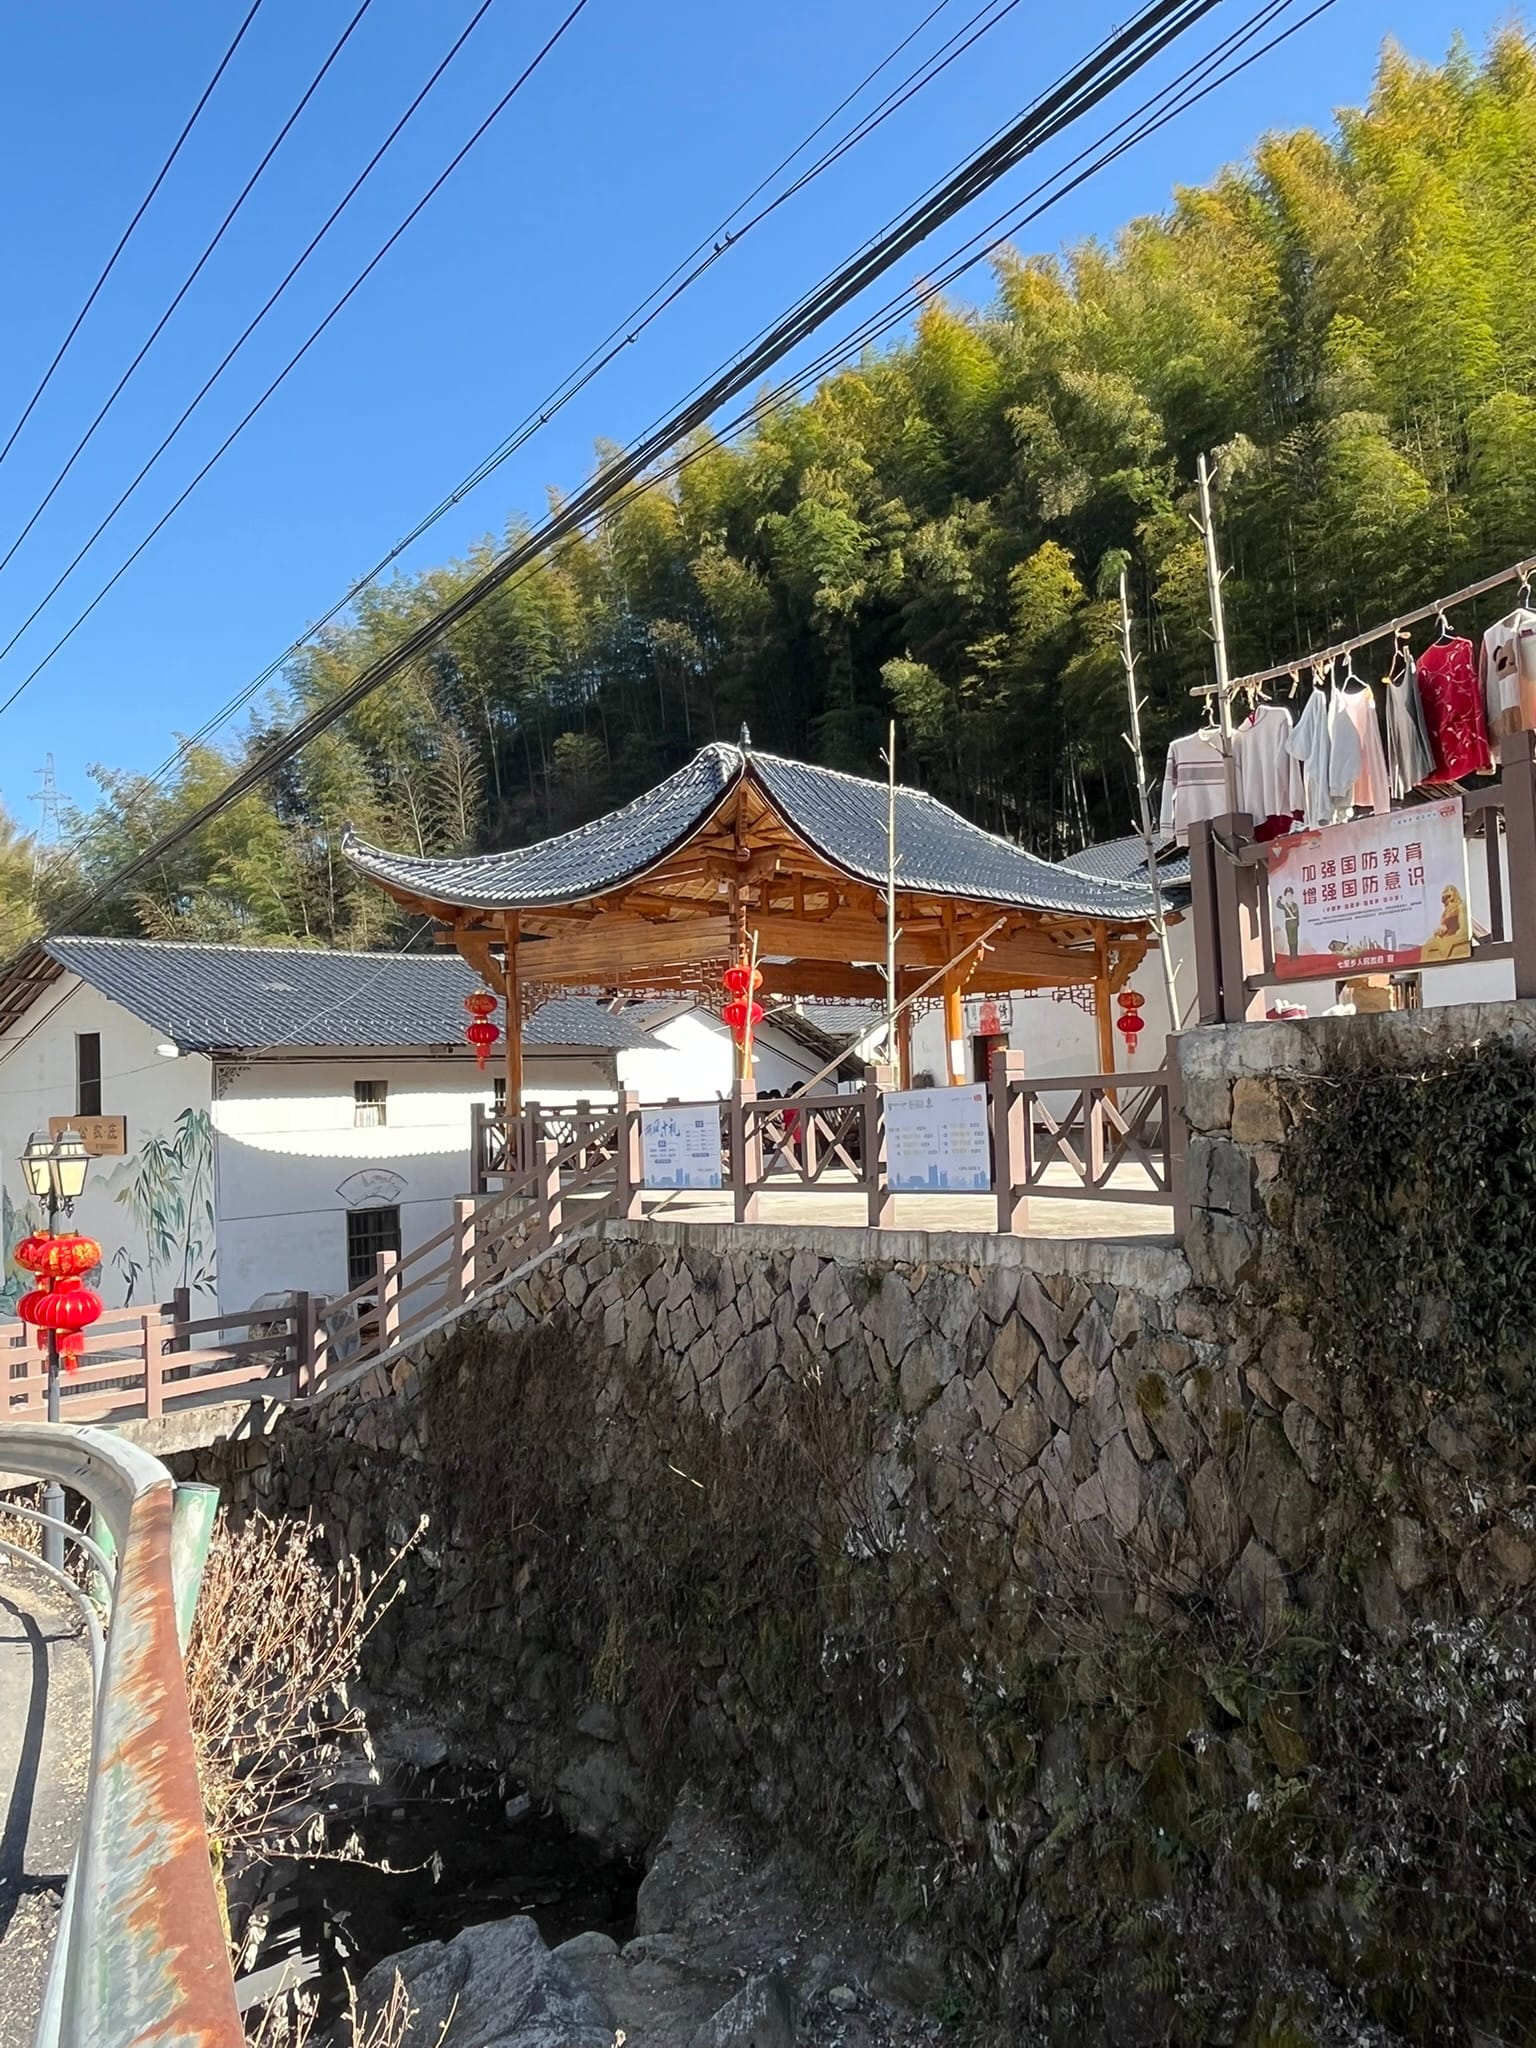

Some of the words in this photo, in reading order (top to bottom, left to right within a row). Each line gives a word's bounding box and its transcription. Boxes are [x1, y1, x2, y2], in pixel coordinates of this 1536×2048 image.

[1302, 842, 1422, 882] 加强国防教育
[1302, 866, 1425, 905] 增强国防意识
